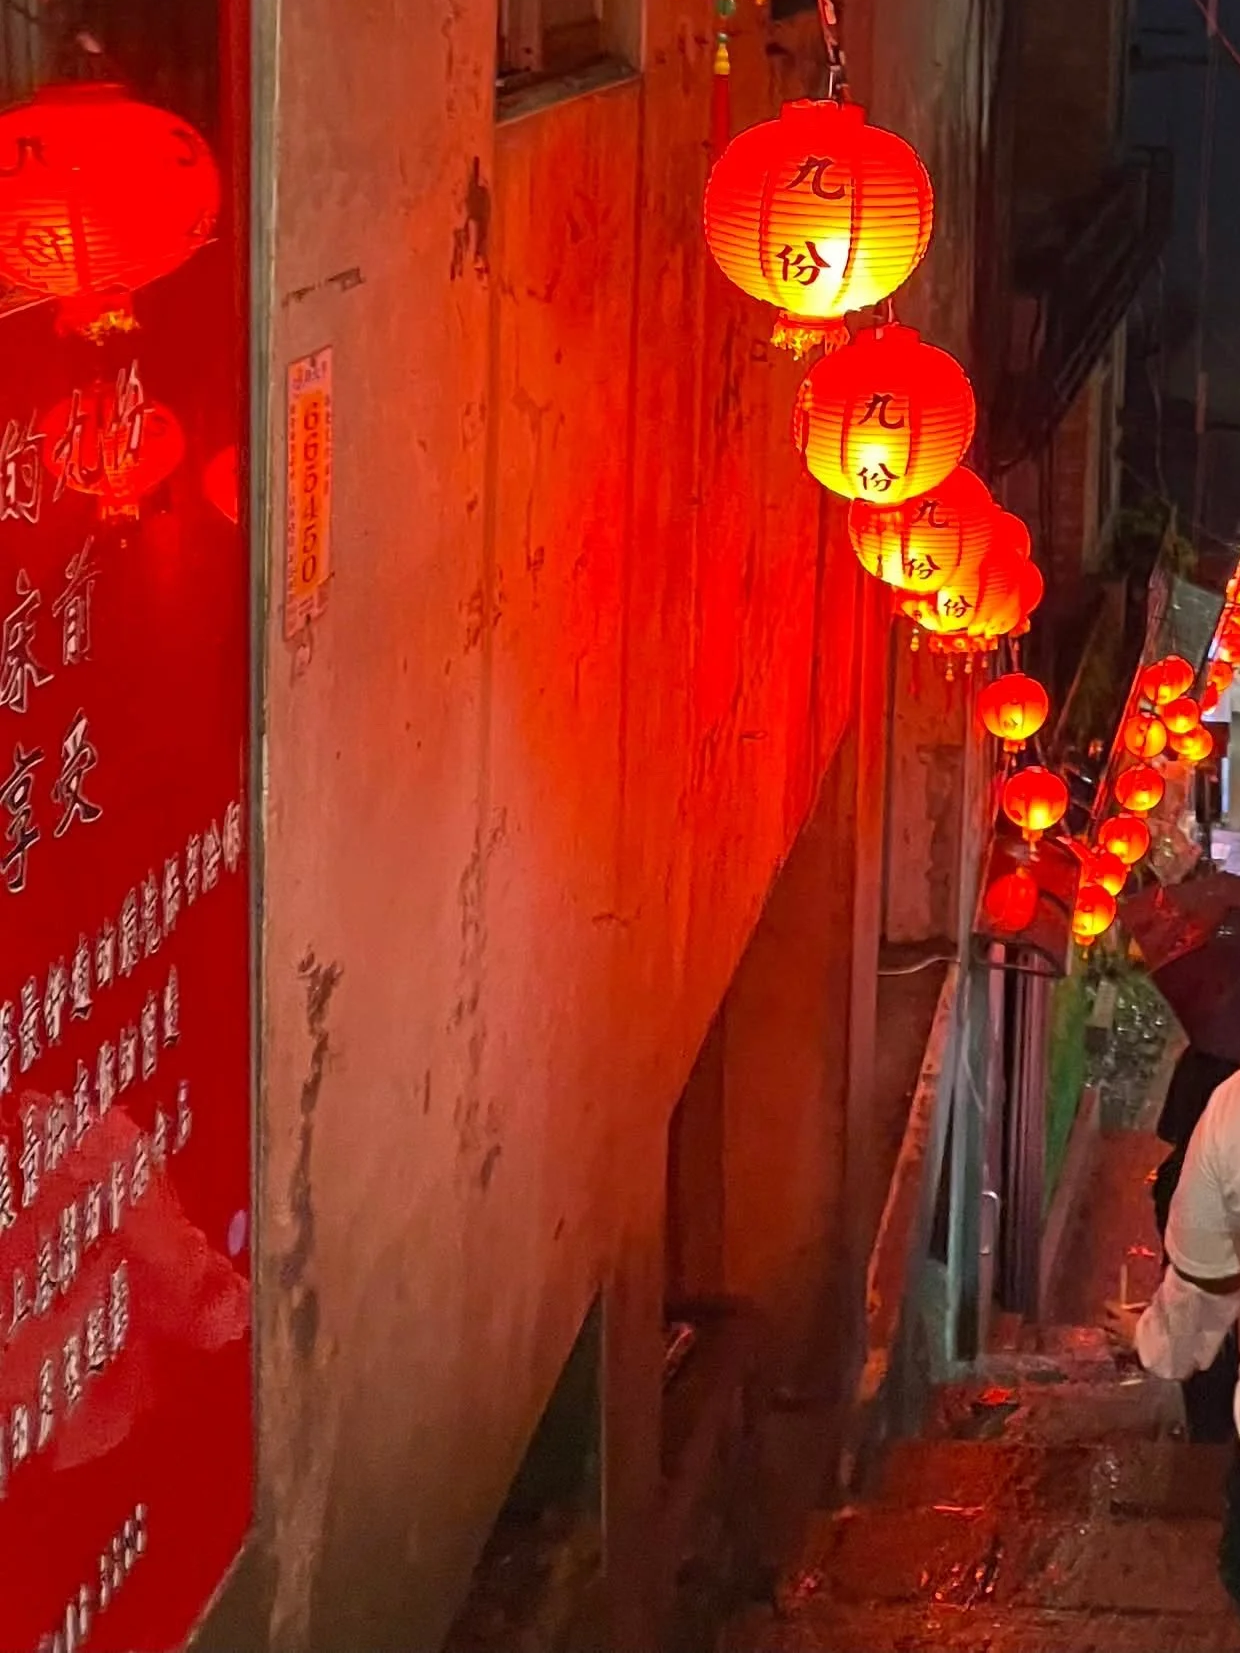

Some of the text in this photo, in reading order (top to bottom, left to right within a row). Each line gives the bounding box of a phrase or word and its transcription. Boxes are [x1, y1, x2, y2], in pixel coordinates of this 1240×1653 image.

[776, 156, 846, 286] 九份
[857, 393, 905, 492] 九份
[905, 499, 949, 580] 九份
[944, 595, 973, 618] 份
